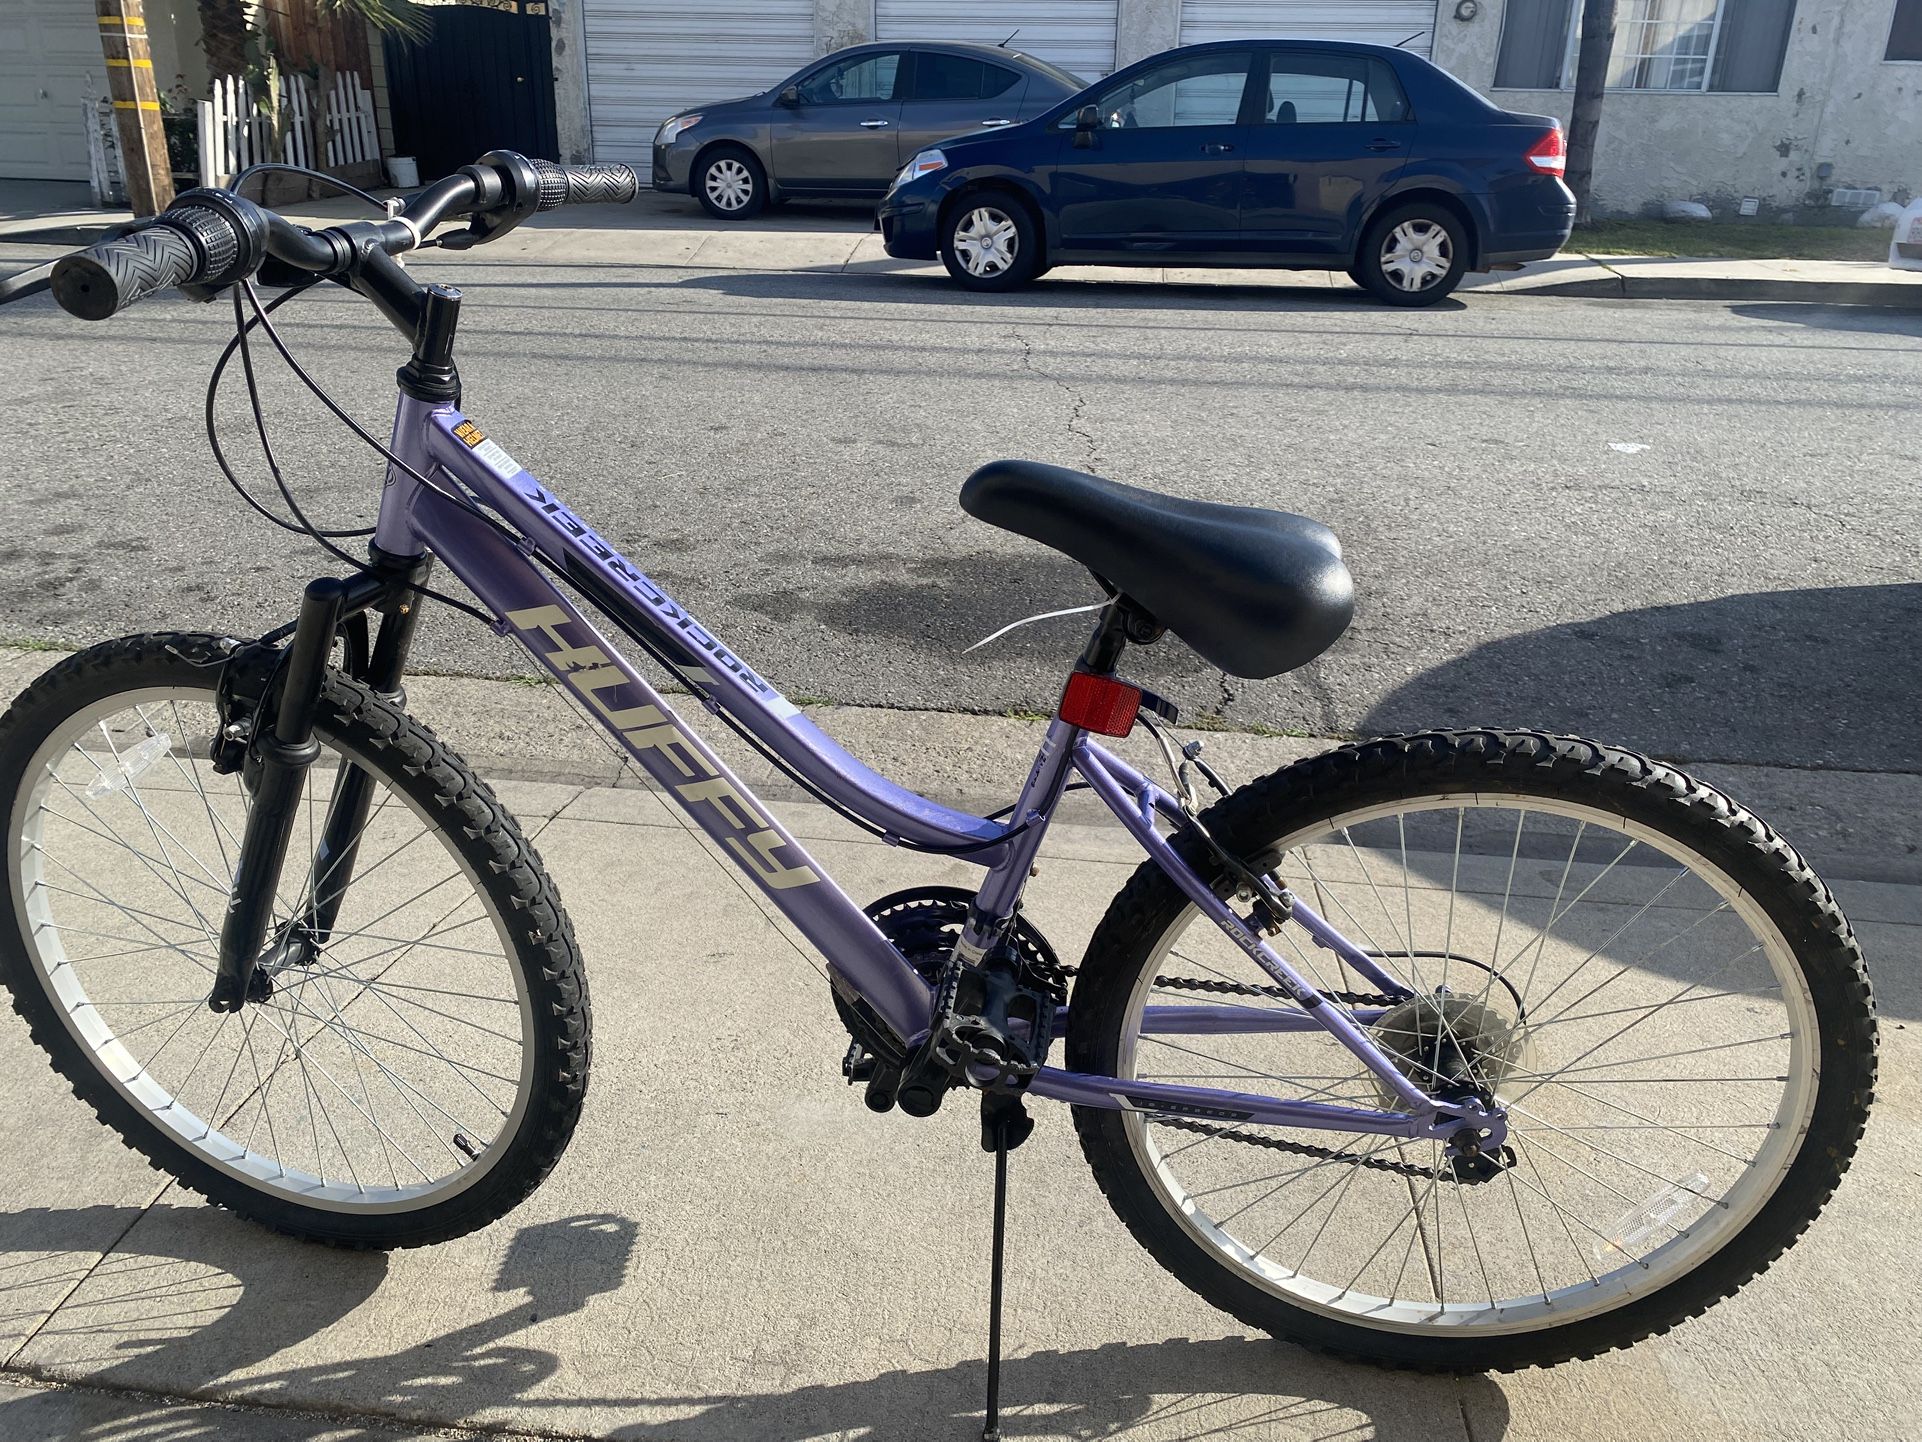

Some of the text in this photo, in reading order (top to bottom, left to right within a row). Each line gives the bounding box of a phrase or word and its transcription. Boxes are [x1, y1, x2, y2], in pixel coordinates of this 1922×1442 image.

[526, 488, 768, 694] ROCKCREEK
[504, 604, 821, 889] HUFFY
[1220, 920, 1306, 996] ROCKCREEK
